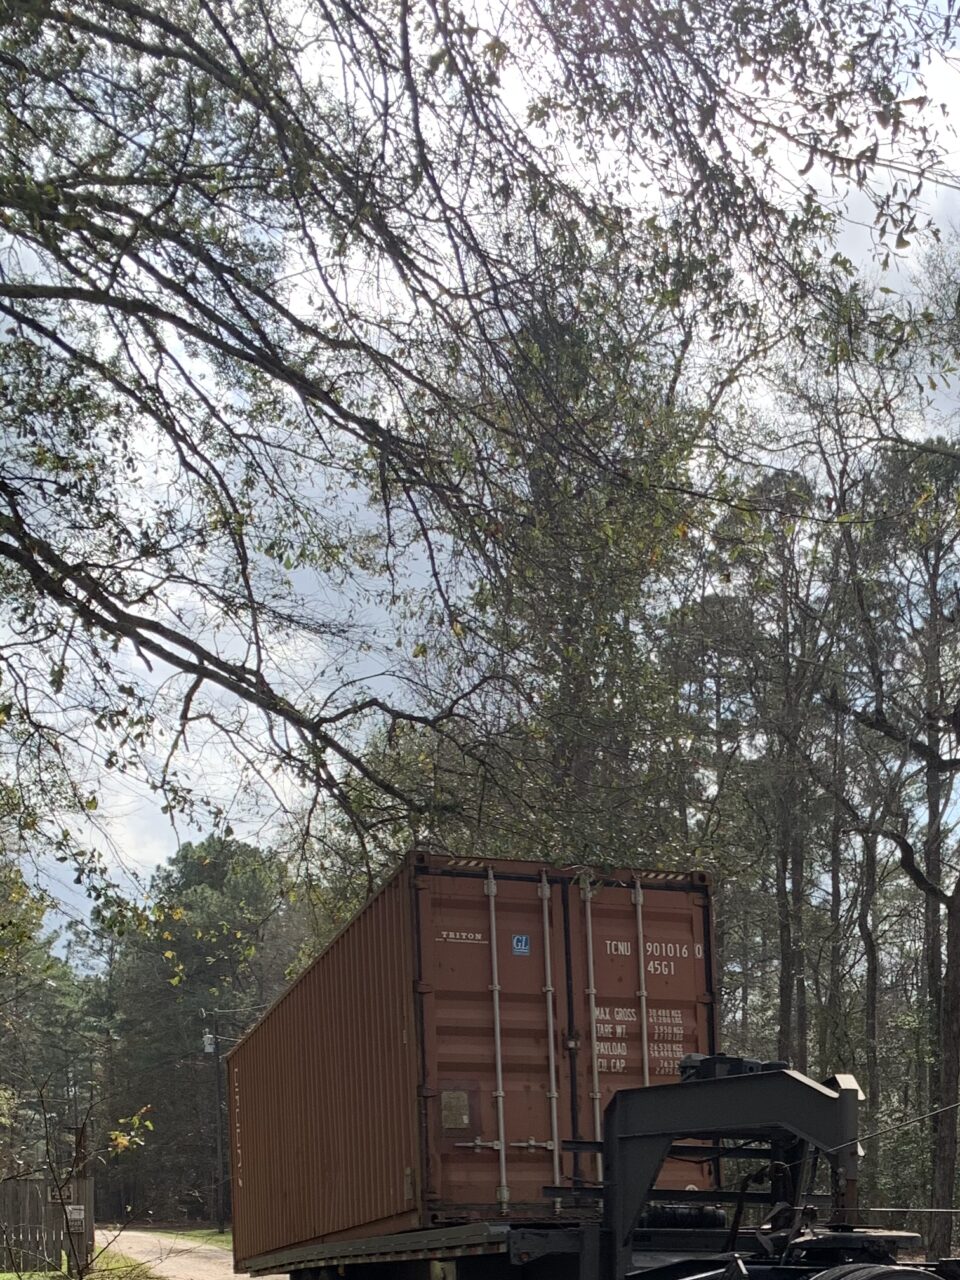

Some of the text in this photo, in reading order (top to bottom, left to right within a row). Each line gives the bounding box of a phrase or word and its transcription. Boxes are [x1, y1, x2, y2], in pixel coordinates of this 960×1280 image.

[441, 931, 482, 940] TRITON
[513, 936, 529, 949] GL
[605, 941, 702, 957] TCNU 901016 0
[647, 961, 674, 975] 45G1
[594, 1007, 637, 1021] MAX GROSS
[596, 1024, 613, 1037] TARE
[595, 1042, 627, 1055] PAYLOAD
